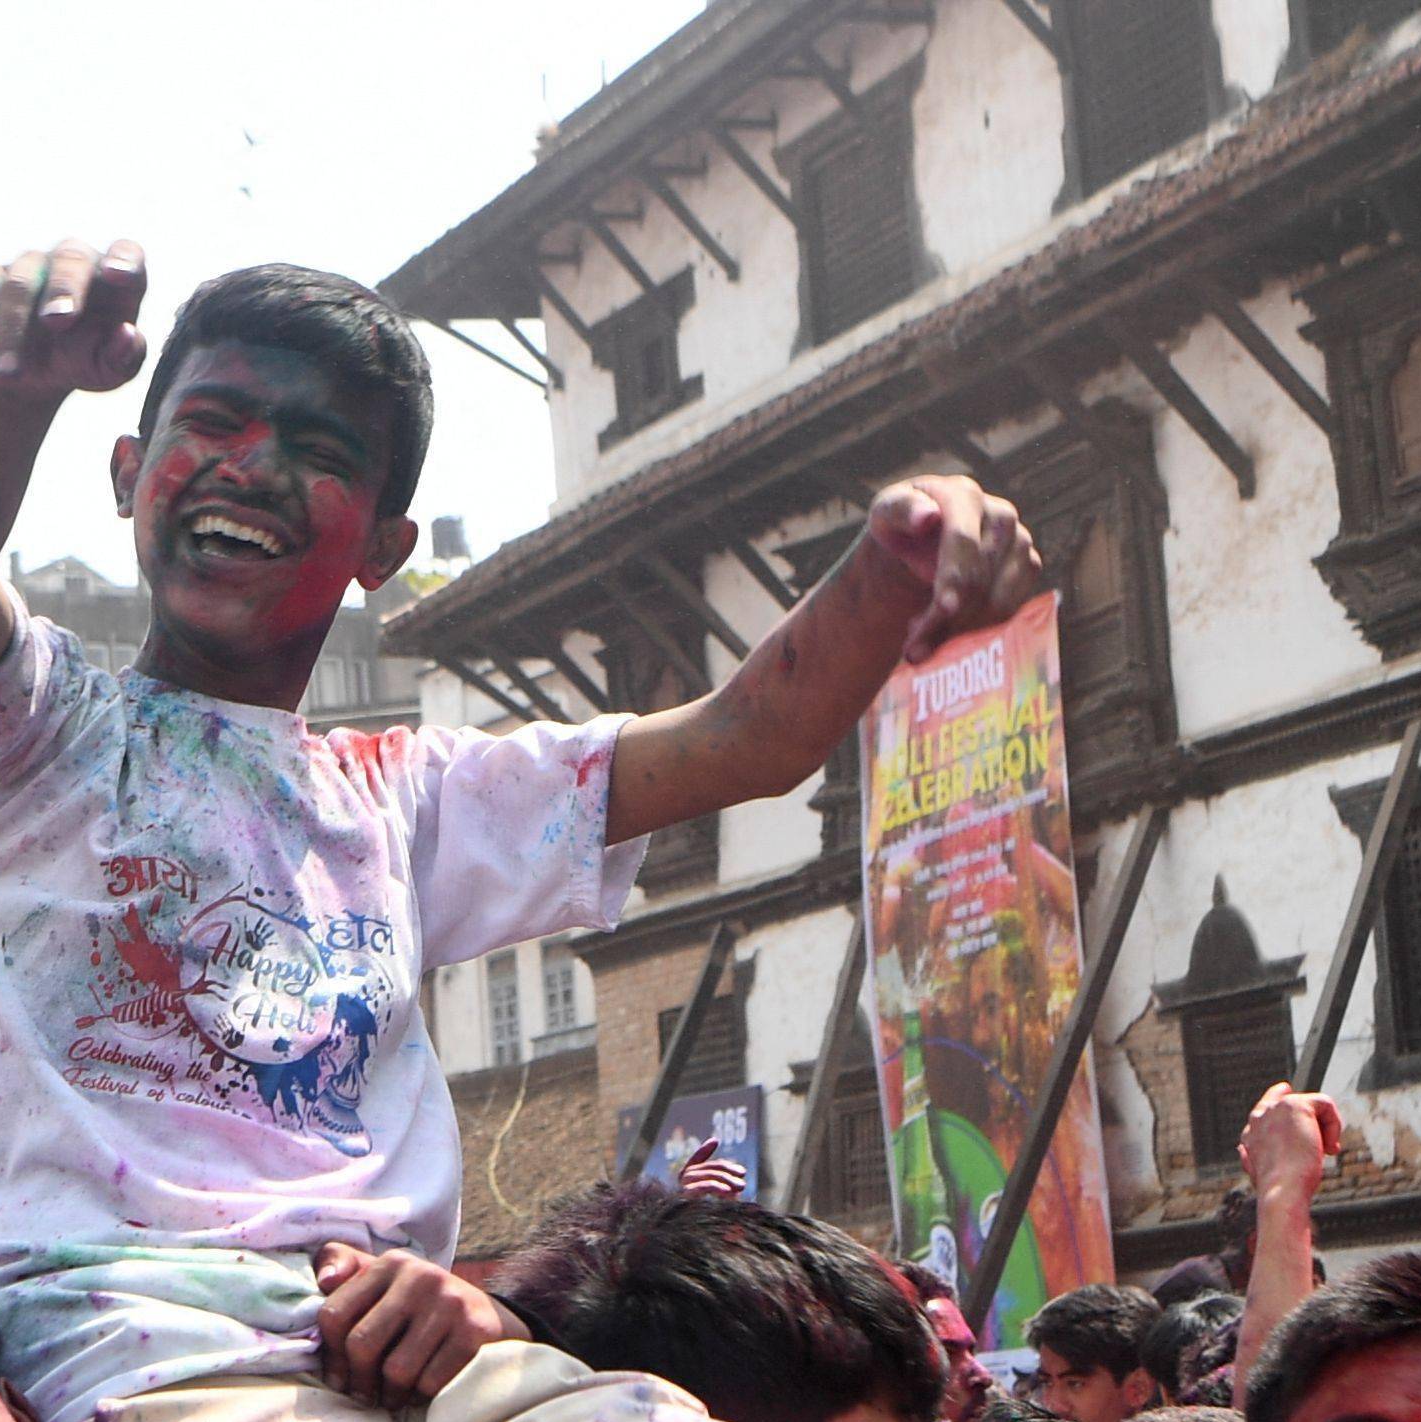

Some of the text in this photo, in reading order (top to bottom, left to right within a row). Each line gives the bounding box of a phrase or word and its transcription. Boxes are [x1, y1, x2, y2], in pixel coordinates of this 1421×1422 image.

[912, 637, 1005, 723] TUBORG
[938, 682, 1054, 767] FESTIVAL
[881, 727, 1050, 832] CELEBRATION
[100, 856, 202, 904] आयो
[194, 920, 319, 996] Happy
[233, 993, 317, 1034] Holi
[62, 1066, 139, 1095] Festival
[146, 1088, 166, 1101] of
[68, 1037, 213, 1082] Celebrating the
